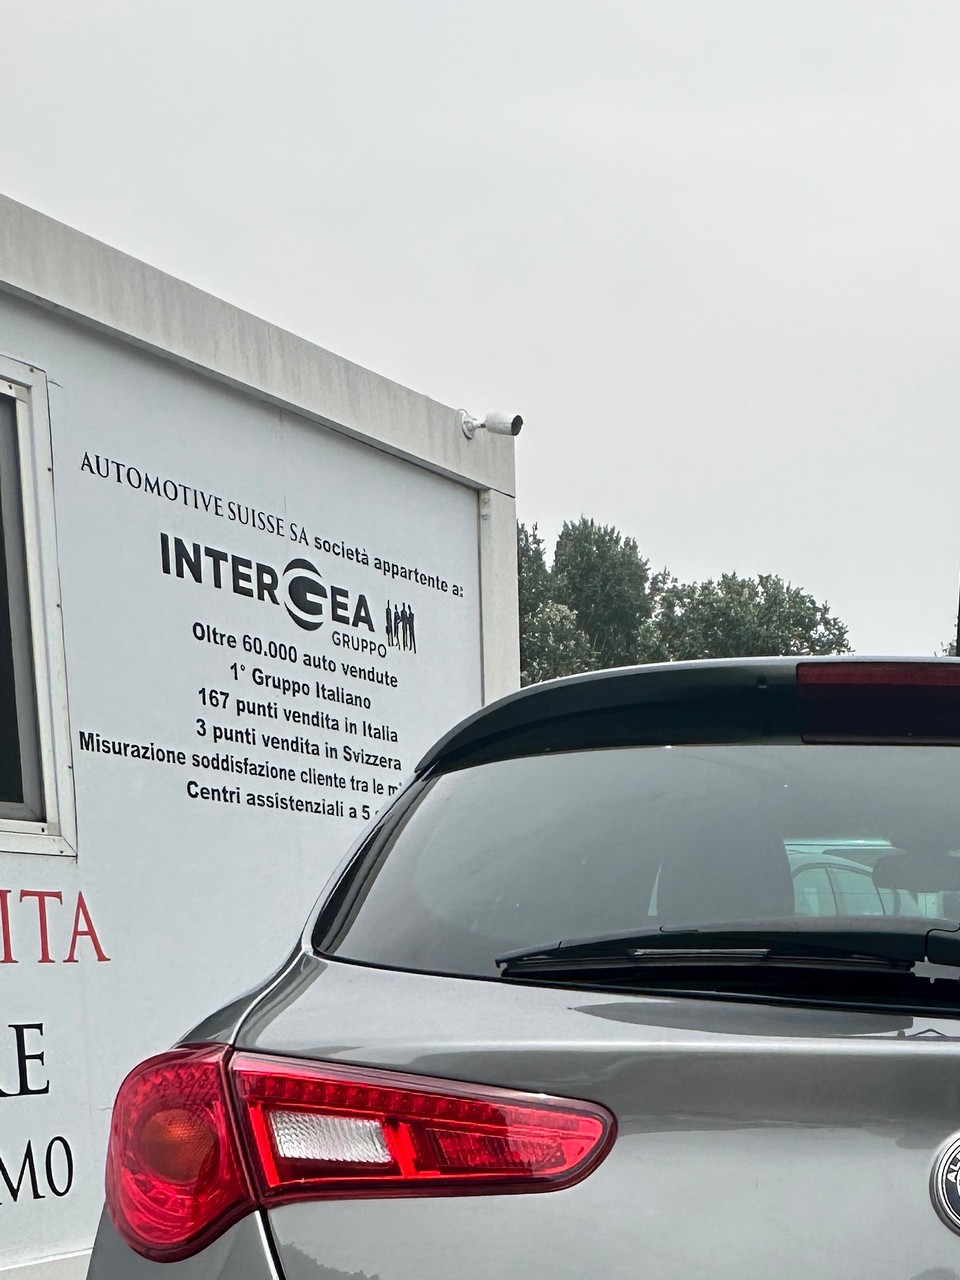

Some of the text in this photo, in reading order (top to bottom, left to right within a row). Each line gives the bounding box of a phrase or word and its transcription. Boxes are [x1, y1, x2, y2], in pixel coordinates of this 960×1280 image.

[81, 452, 463, 598] AUTOMOTIVE SUISSE SA società appartente a:
[192, 622, 398, 688] Oltre 60.000 auto vendute
[332, 631, 387, 658] GRUPPO
[230, 662, 371, 709] 1° Gruppo Italiano
[198, 687, 398, 743] 167 punti vendita in Italia
[79, 731, 186, 765] Misurazione
[192, 753, 296, 782] soddisfazione
[301, 767, 346, 789] cliente
[350, 775, 369, 793] tra
[373, 778, 384, 795] le
[196, 718, 402, 771] 3 punti vendita in Svizzera
[187, 780, 370, 820] Centri assistenziali a 5
